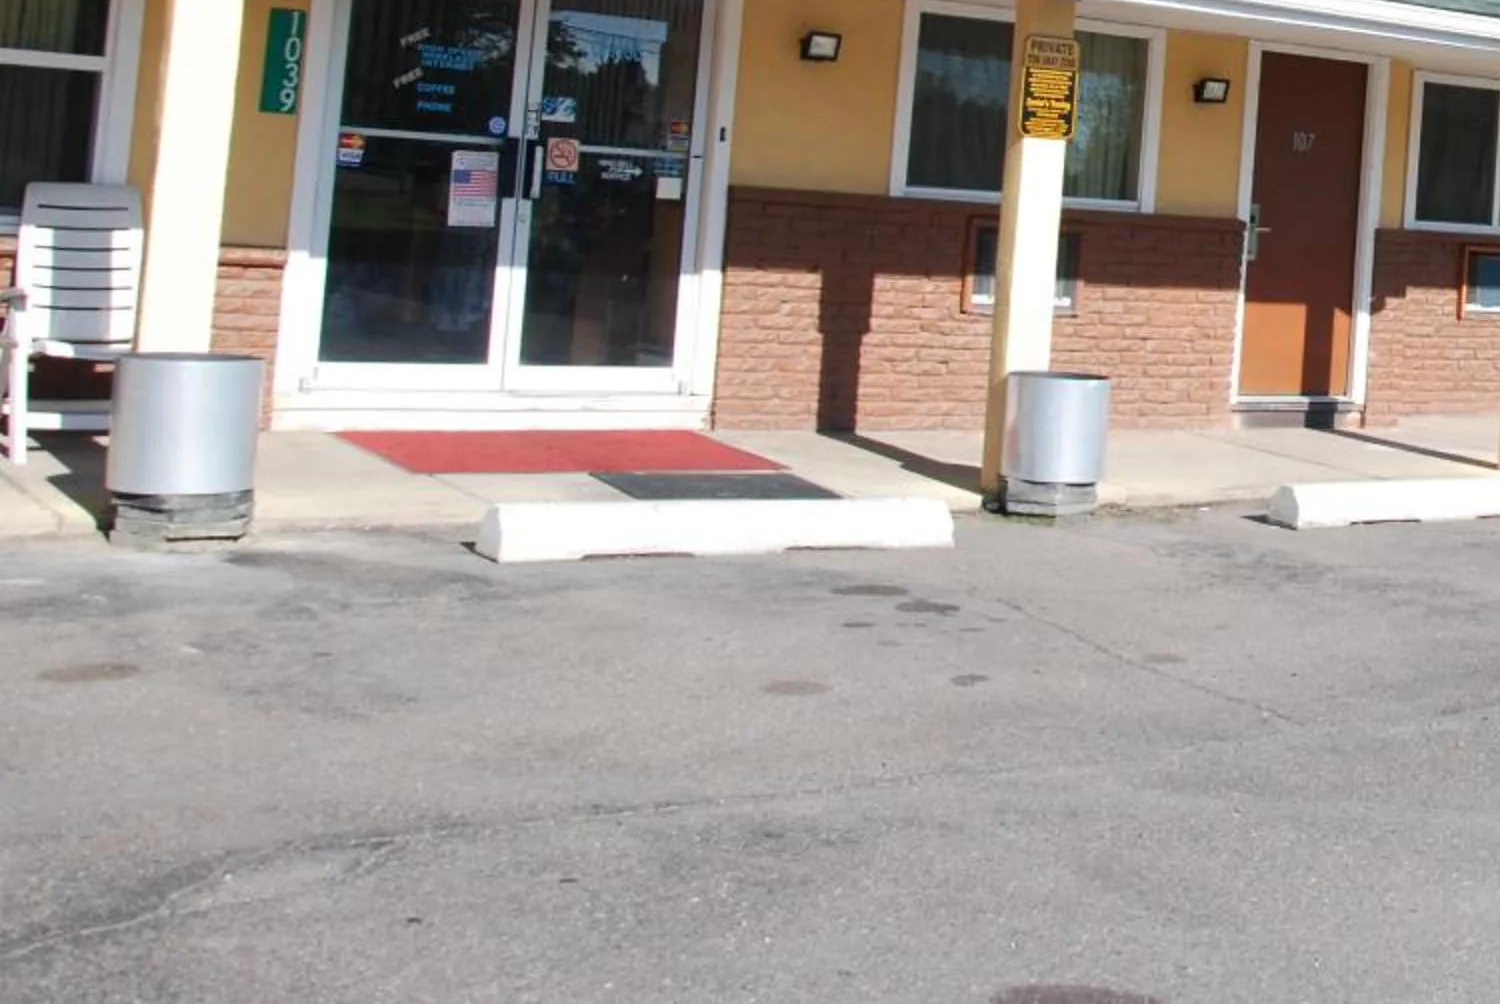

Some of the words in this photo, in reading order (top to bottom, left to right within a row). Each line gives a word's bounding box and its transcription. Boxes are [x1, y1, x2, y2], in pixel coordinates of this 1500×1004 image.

[1030, 39, 1075, 55] PRIVATE
[280, 11, 300, 112] 1039
[1293, 131, 1317, 152] 107
[547, 171, 577, 184] PULL
